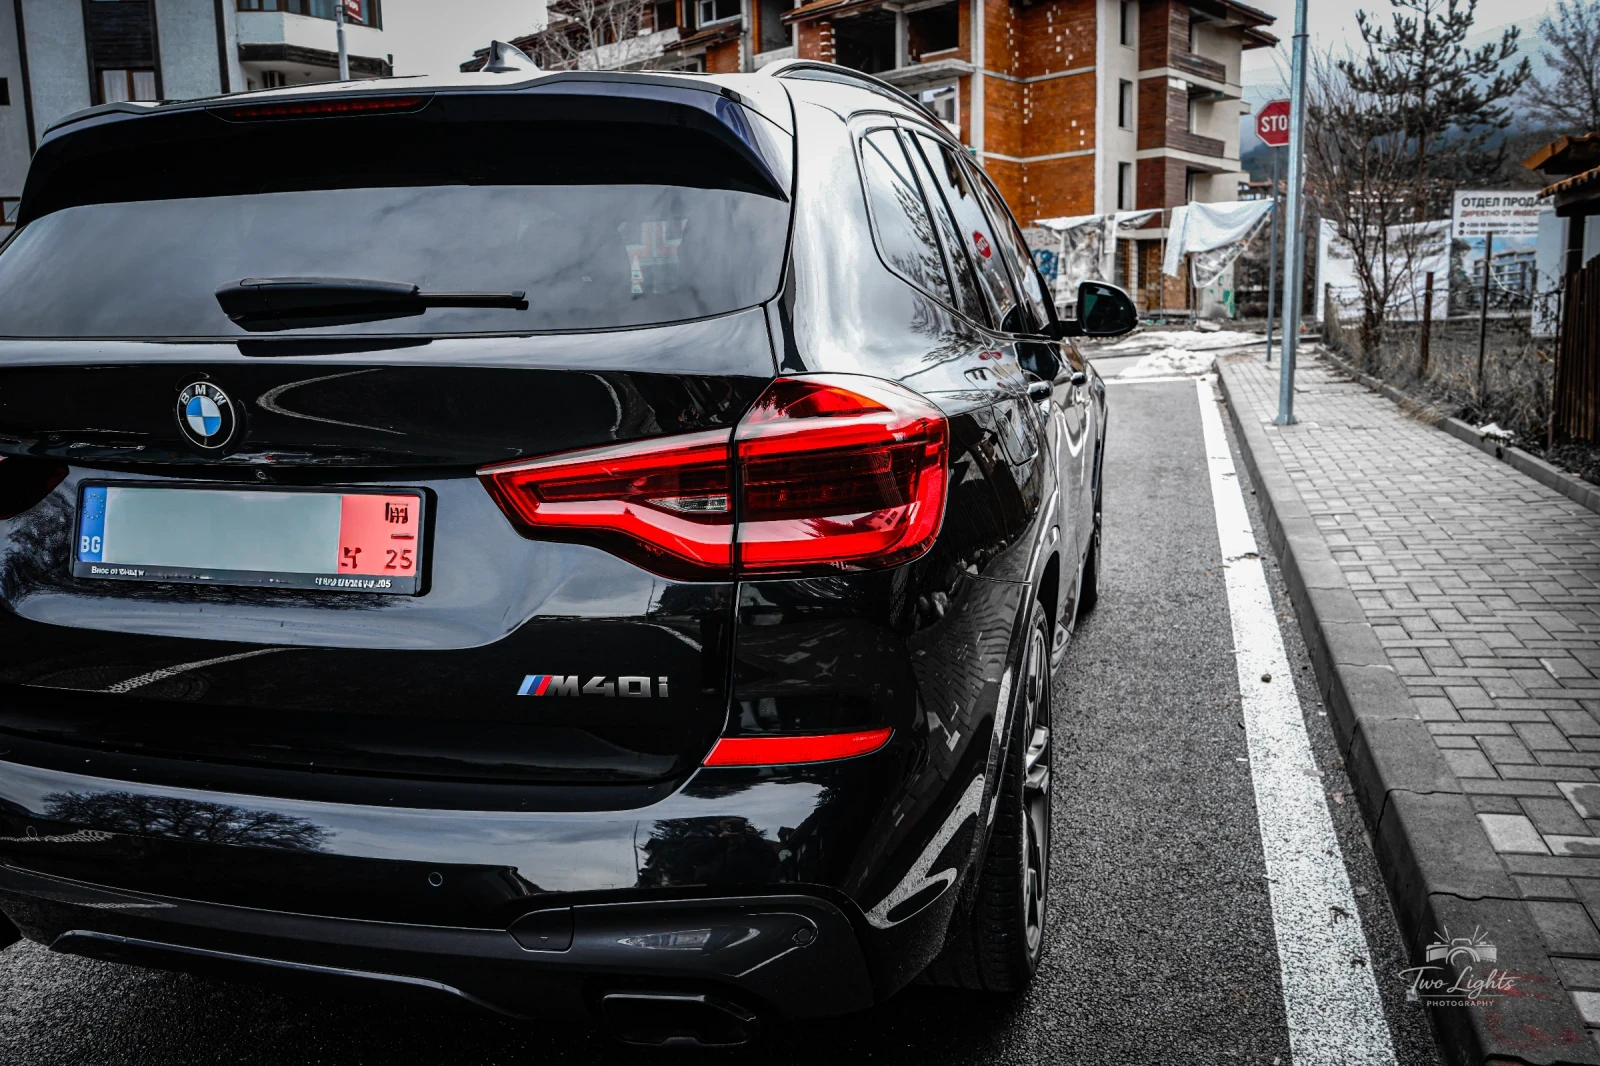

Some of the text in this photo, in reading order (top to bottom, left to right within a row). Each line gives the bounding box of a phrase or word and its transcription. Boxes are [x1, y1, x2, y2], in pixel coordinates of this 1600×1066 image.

[1261, 114, 1289, 132] STO
[1461, 197, 1500, 208] ОТДЕЛ
[181, 384, 226, 406] BMW
[80, 535, 101, 553] BG
[385, 549, 412, 569] 25
[543, 675, 669, 697] M40i
